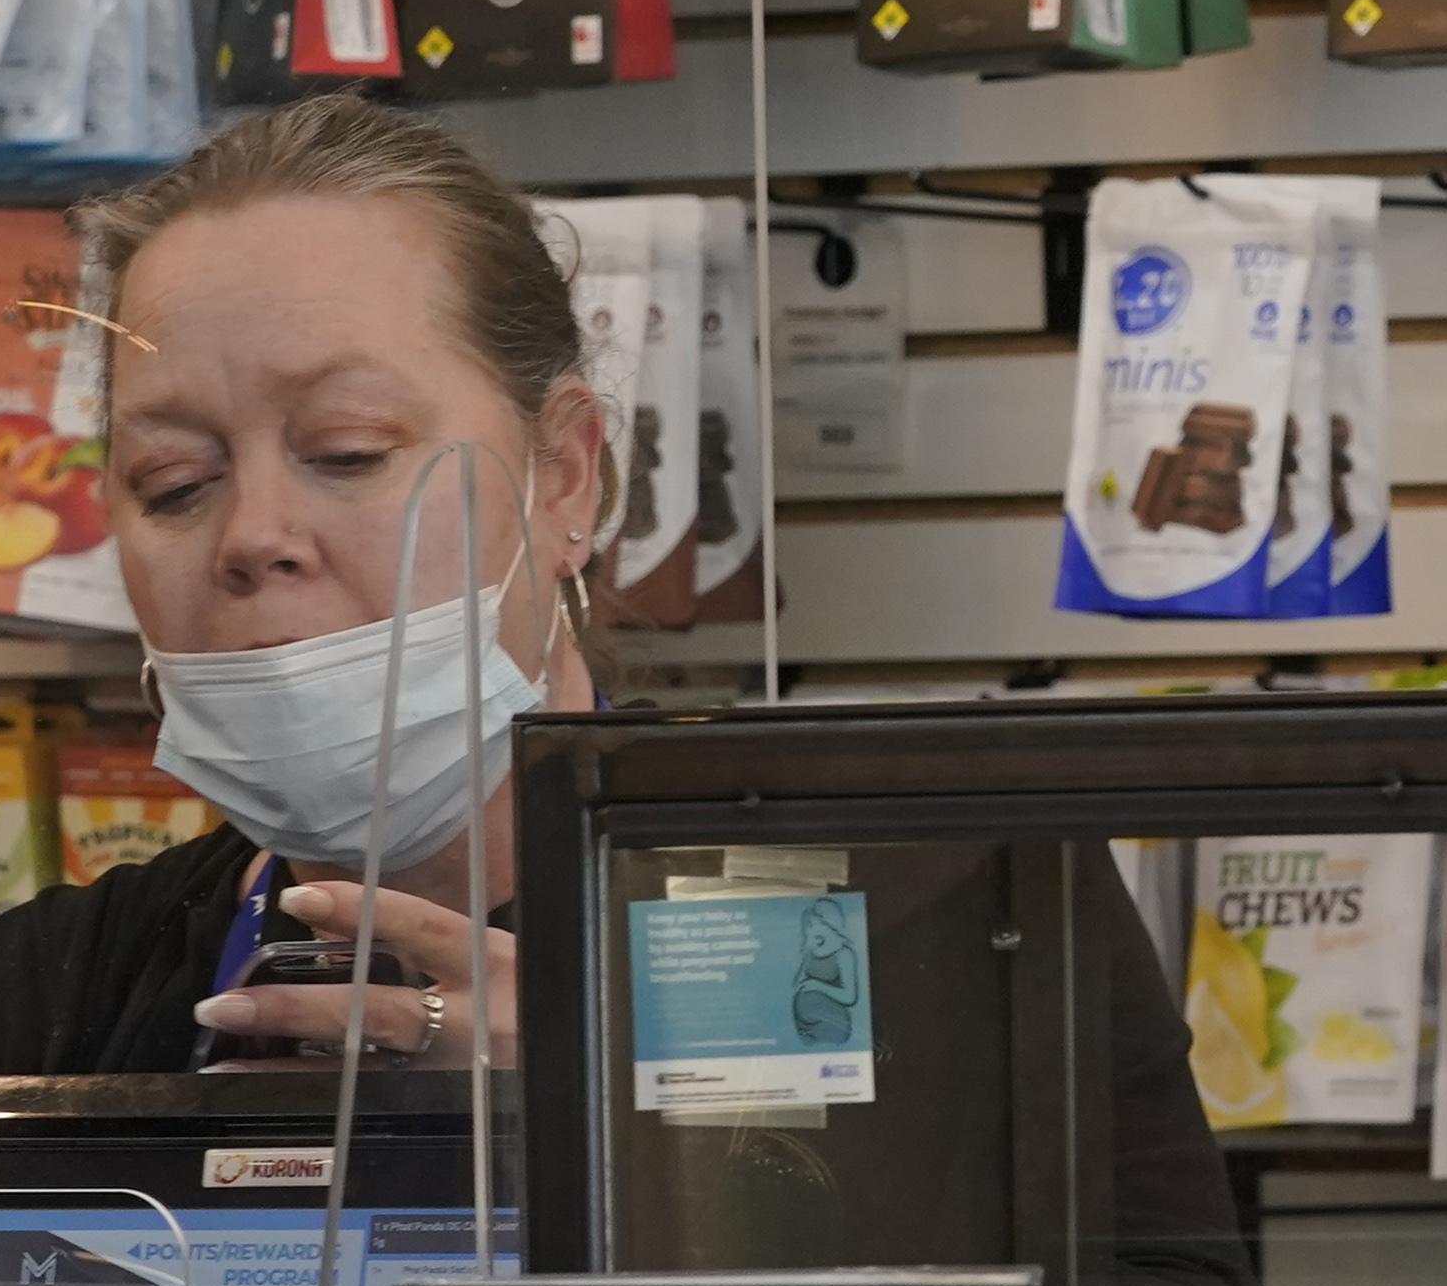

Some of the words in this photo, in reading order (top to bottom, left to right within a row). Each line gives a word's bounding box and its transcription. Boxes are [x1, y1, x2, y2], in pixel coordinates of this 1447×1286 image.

[1105, 346, 1209, 395] minis
[1218, 850, 1327, 887] FRUIT
[1217, 886, 1364, 931] CHEWS
